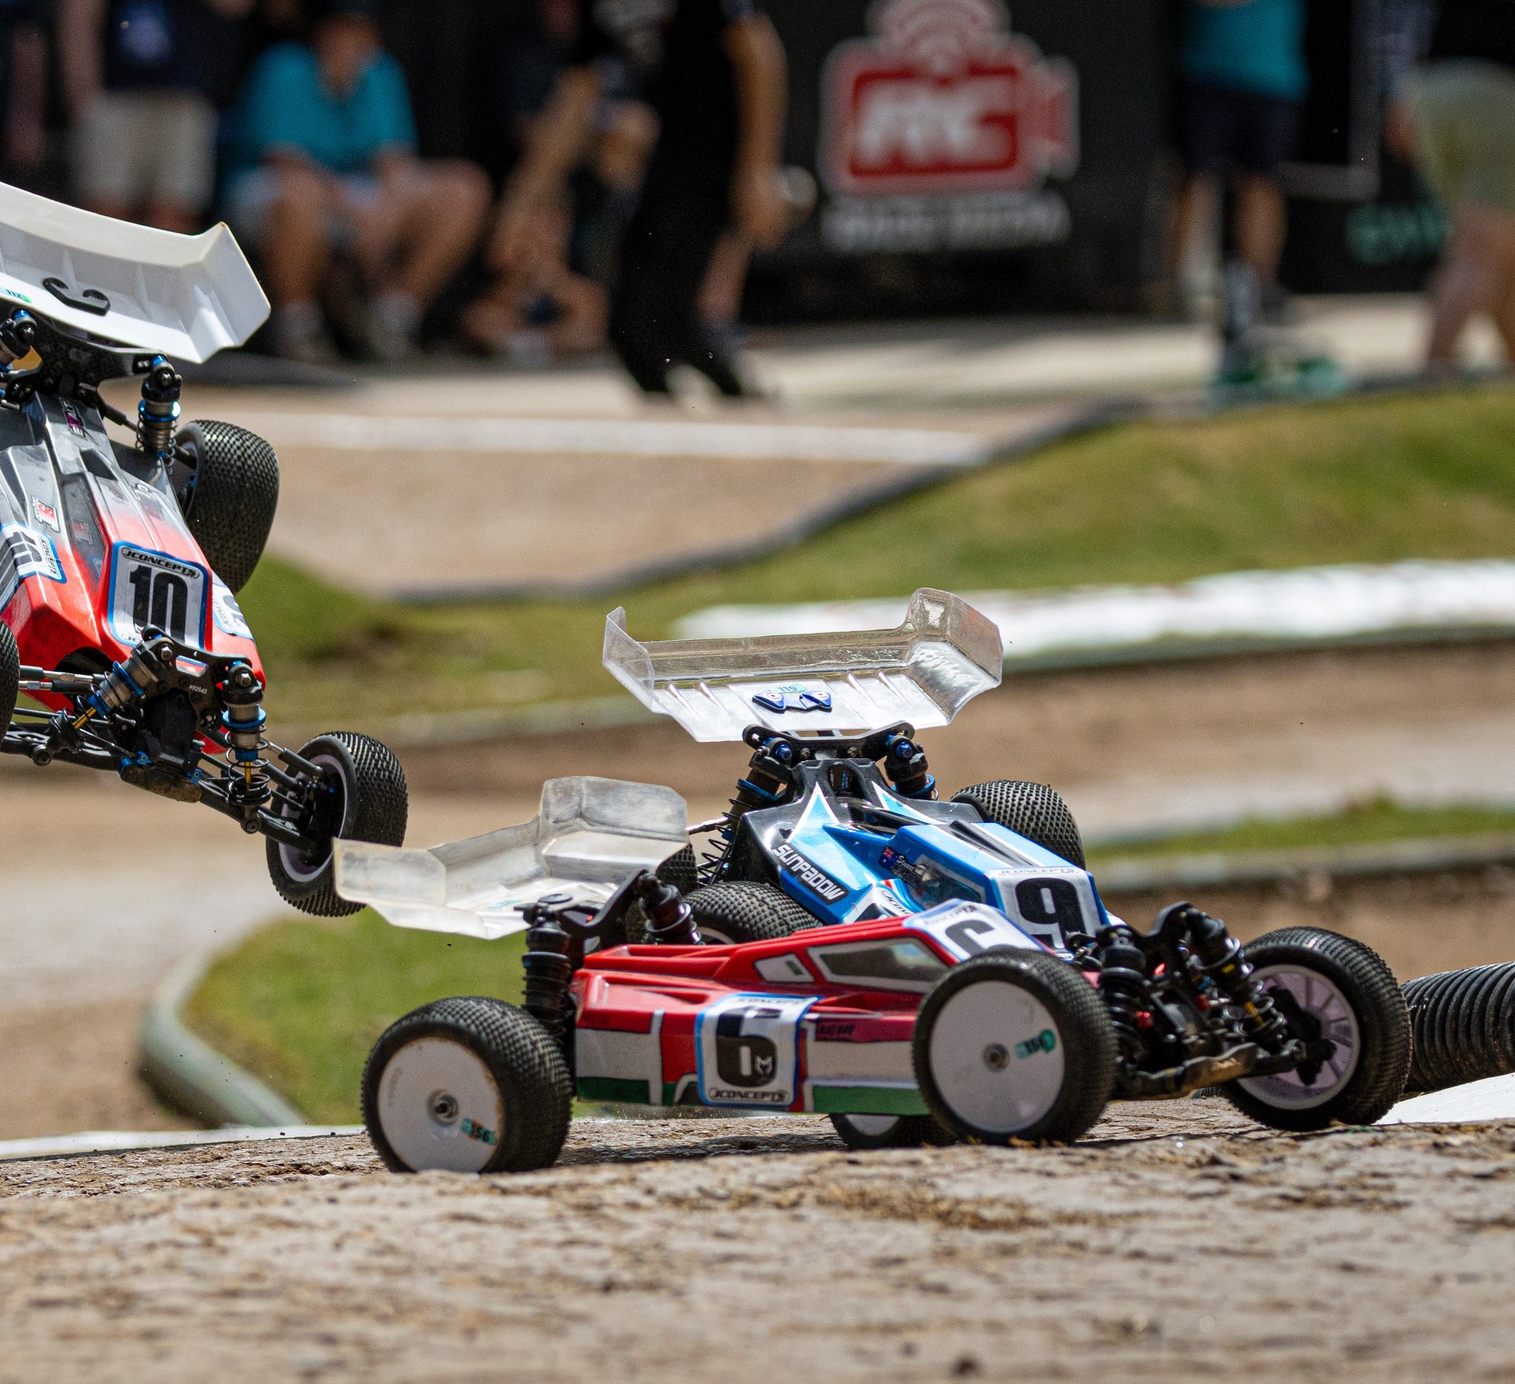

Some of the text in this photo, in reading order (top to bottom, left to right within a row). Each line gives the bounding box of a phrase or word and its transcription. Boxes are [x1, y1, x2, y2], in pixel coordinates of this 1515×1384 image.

[122, 549, 197, 579] JCONCEPTS
[129, 564, 189, 645] 10
[1015, 877, 1088, 950] 9
[716, 1006, 782, 1087] 6
[713, 1089, 787, 1103] JCONCEPTS
